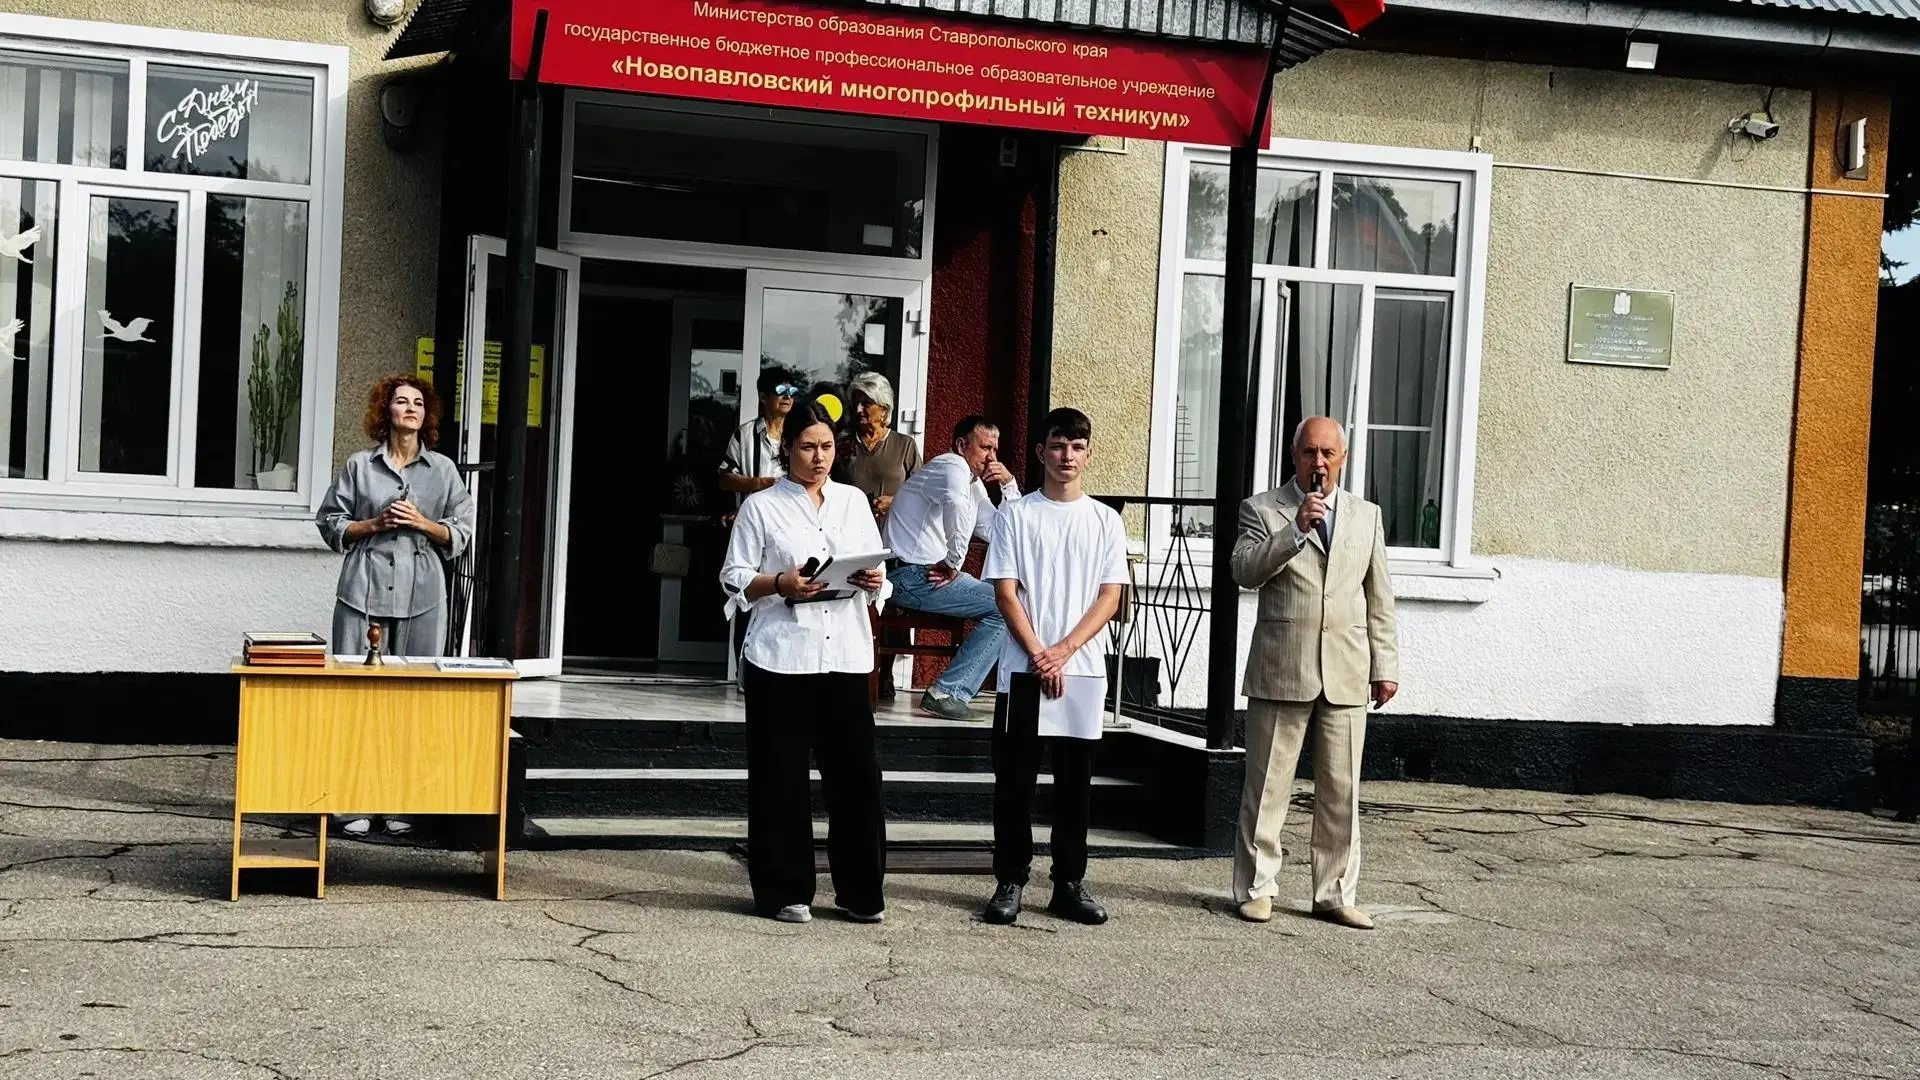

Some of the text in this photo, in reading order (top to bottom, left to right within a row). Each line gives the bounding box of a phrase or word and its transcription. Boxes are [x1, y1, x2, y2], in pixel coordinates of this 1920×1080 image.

[564, 23, 1215, 99] государственное бюджетное профессиональное образовательное учреждение
[693, 0, 1108, 60] Министерство образования Ставропольского края
[157, 109, 184, 143] С
[611, 55, 1190, 130] «Новопавловский многопрофильный техникум»
